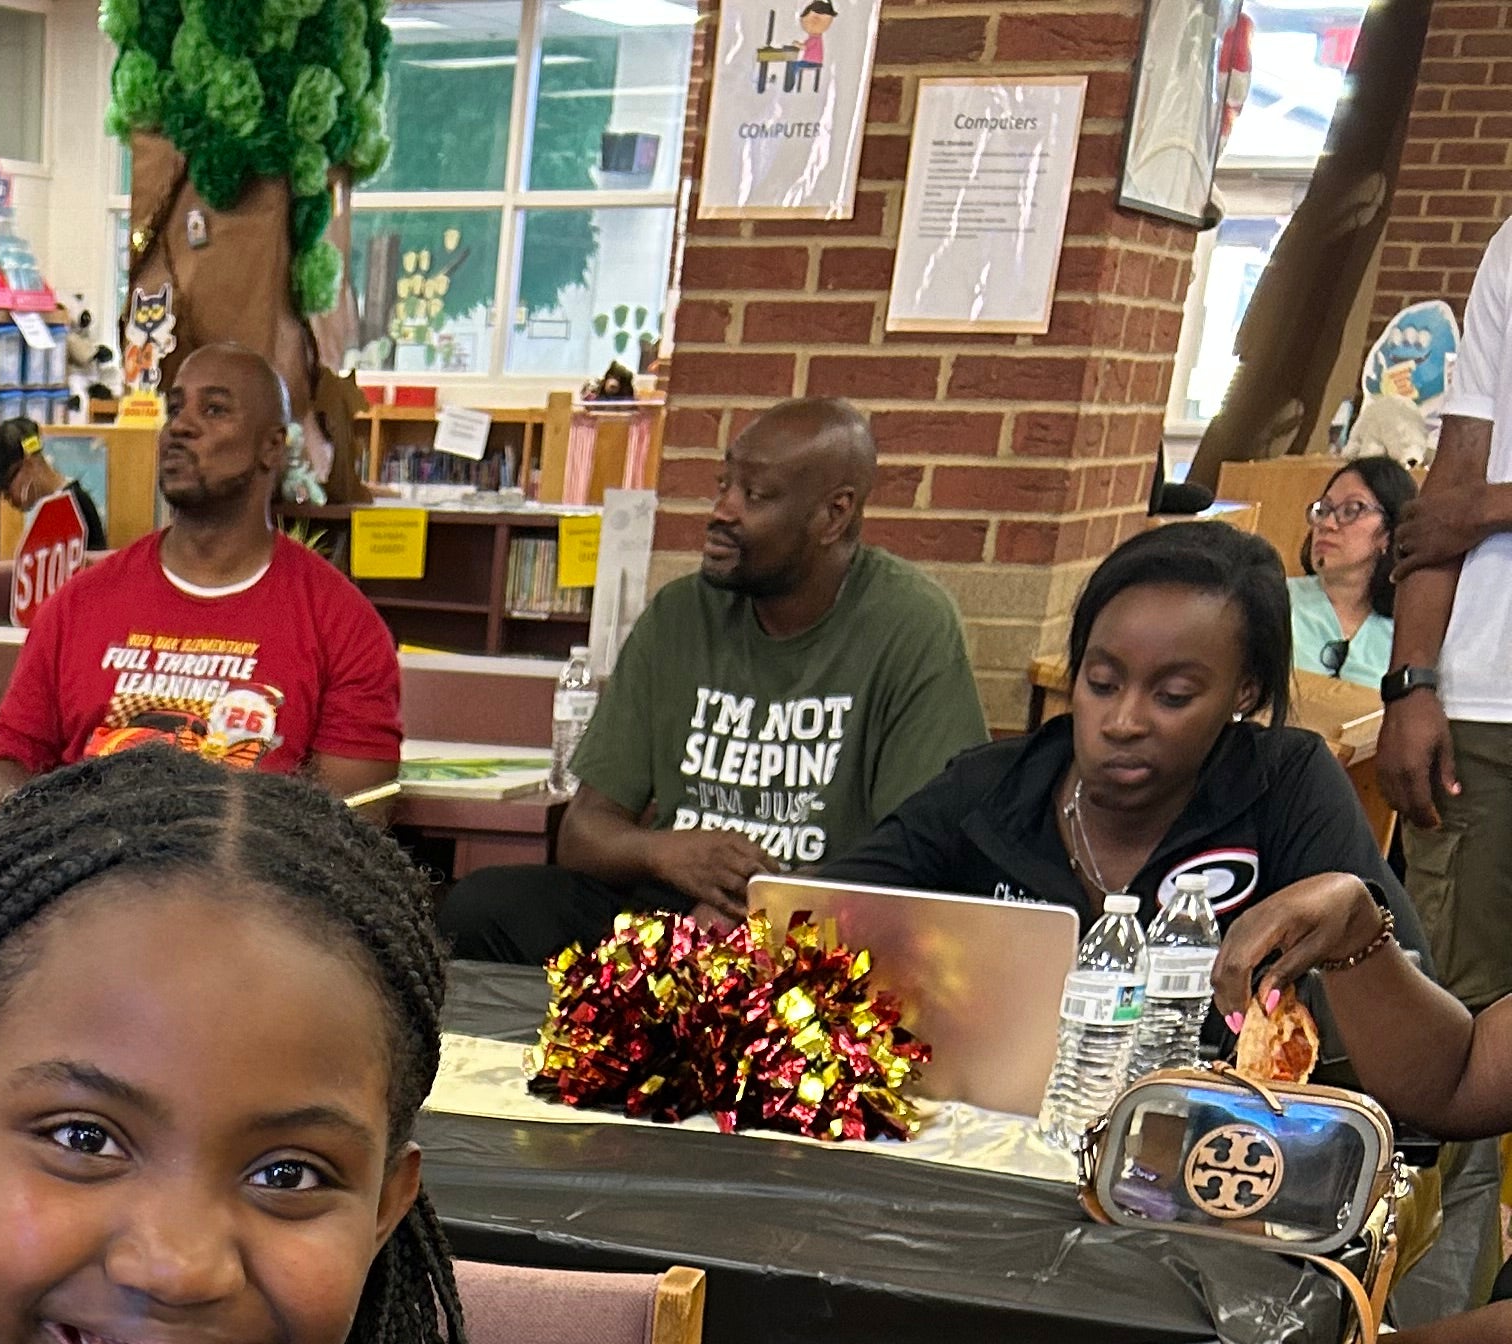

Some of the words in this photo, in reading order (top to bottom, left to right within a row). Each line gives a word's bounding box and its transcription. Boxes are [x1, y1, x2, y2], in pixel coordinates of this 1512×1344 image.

[739, 122, 821, 139] COMPUTER
[954, 114, 1038, 132] Computers
[15, 538, 82, 611] STOP
[101, 647, 152, 670] FULL
[154, 650, 258, 680] THROTTLE
[114, 672, 230, 702] LEARNING!
[691, 687, 756, 739] I'M
[758, 696, 854, 742] NOT
